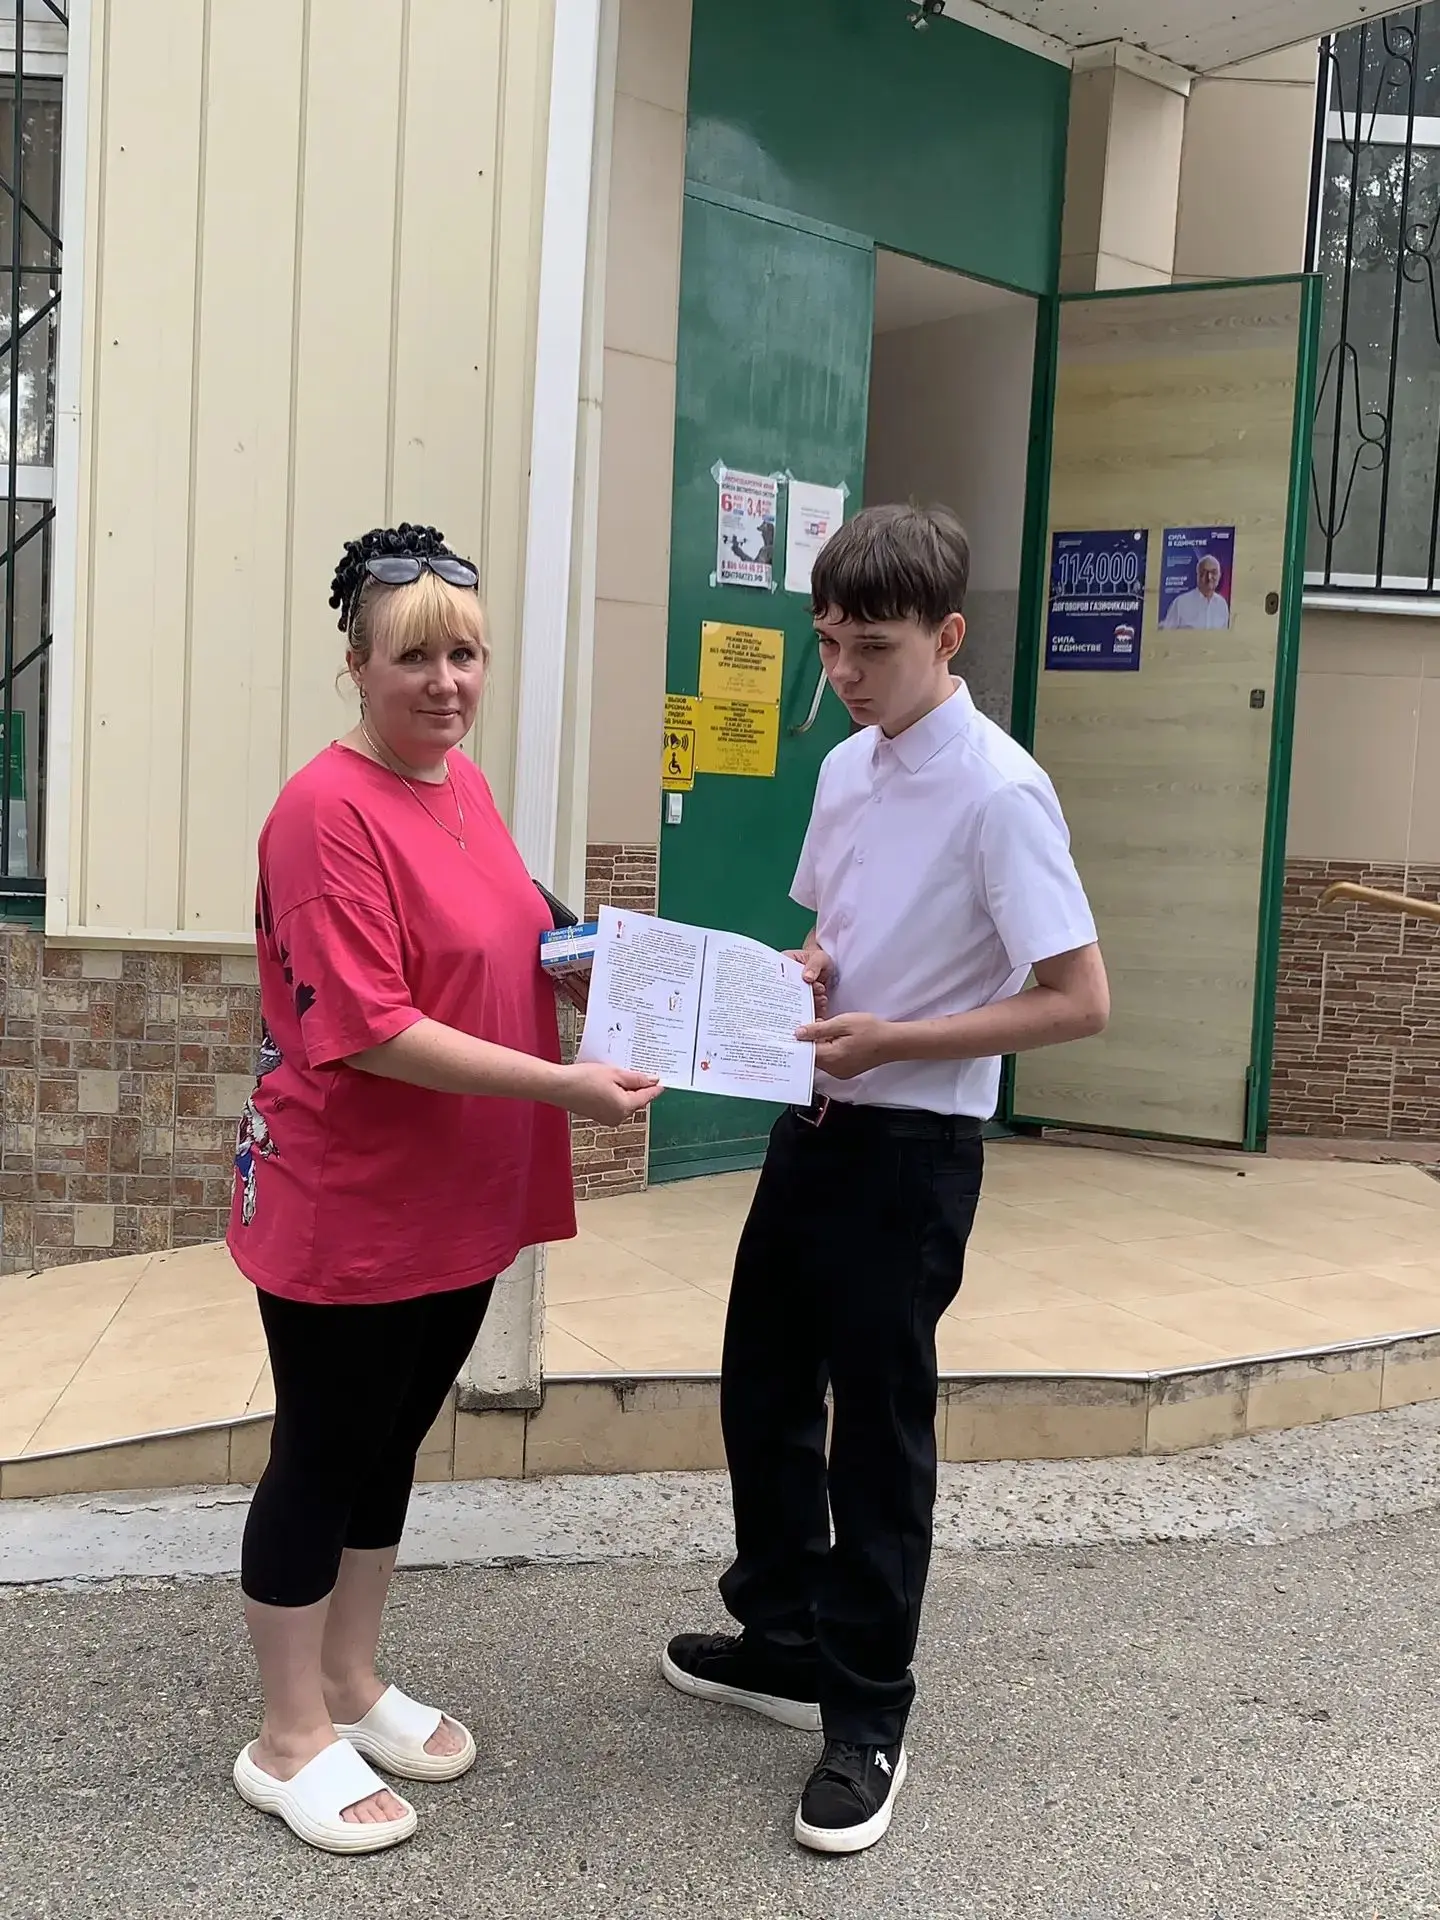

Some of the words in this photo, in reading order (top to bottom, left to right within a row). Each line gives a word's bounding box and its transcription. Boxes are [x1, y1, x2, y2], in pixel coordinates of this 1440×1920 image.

[721, 493, 733, 512] 6
[1173, 539, 1207, 547] ЕДИНСТВЕ
[1058, 552, 1139, 585] 114000
[1052, 601, 1090, 612] ДОГОВОРОВ
[1090, 601, 1139, 611] ГАЗИФИКАЦИИ
[1052, 635, 1075, 644] СИЛА
[1059, 643, 1101, 653] ЕДИНСТВЕ
[664, 703, 693, 712] ЕРСОНАЛА
